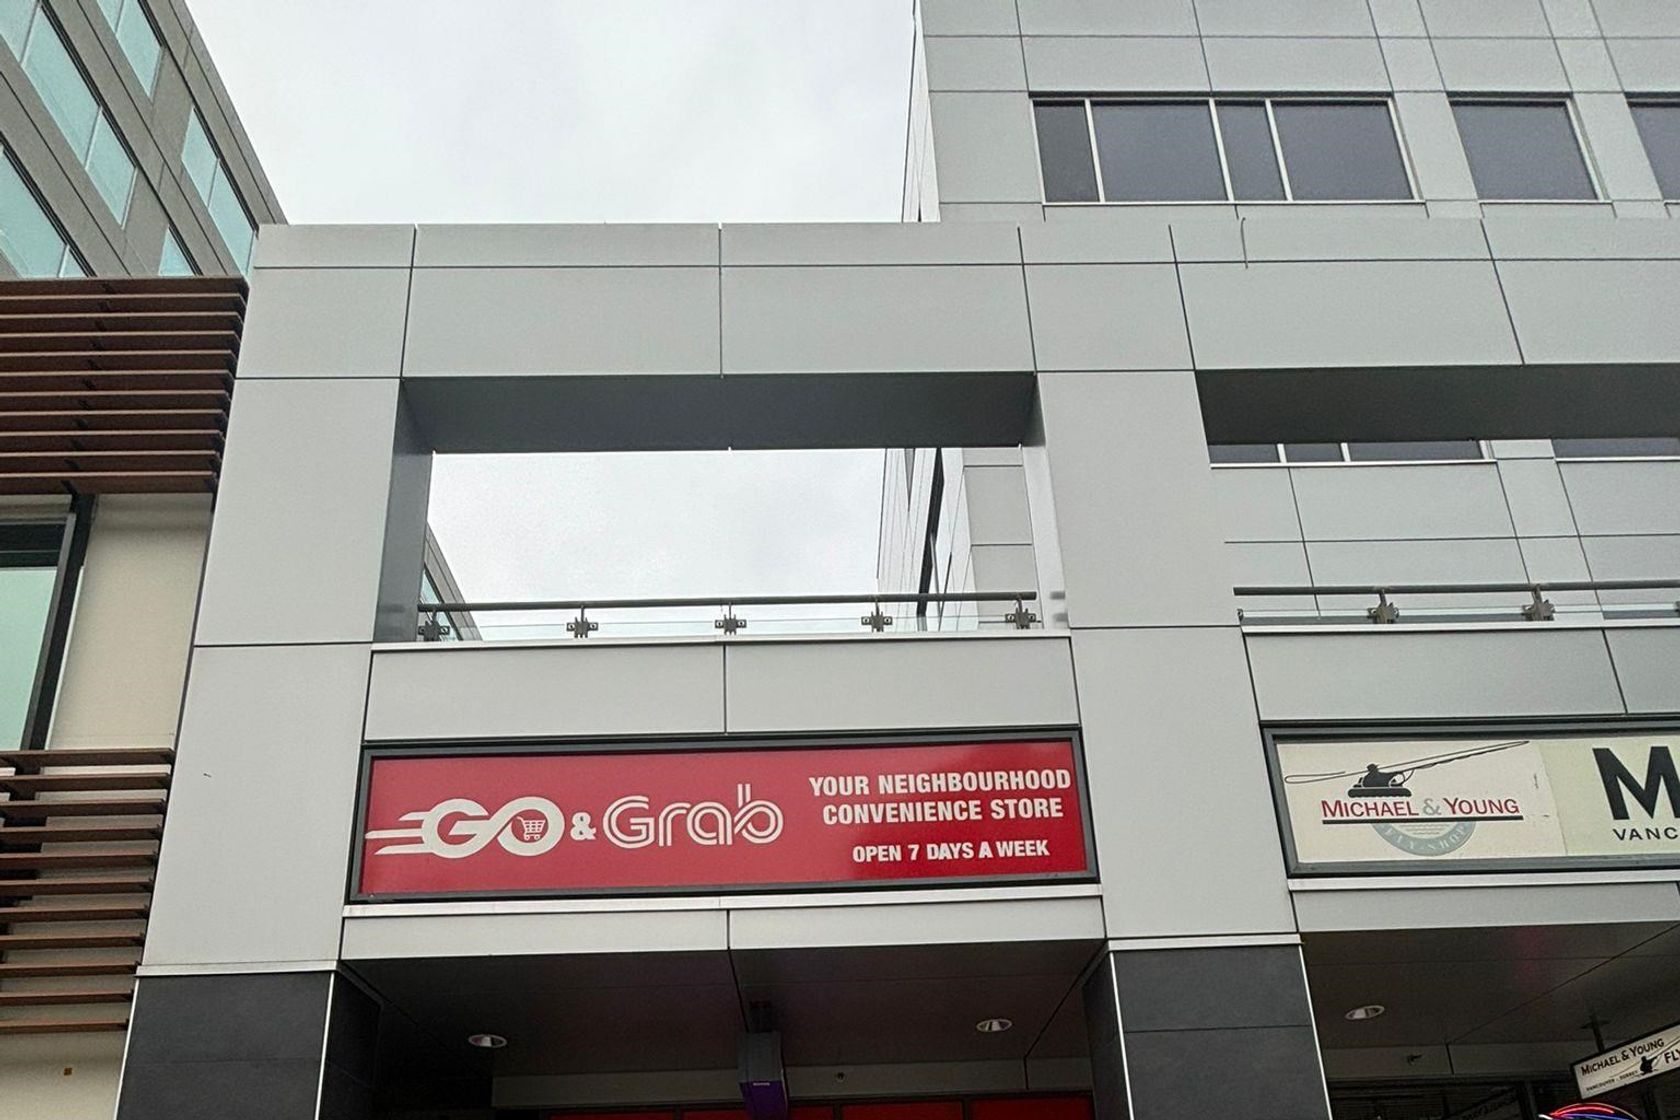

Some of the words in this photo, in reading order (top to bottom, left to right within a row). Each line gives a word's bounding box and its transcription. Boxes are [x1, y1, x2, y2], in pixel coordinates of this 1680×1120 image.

[808, 775, 870, 797] YOUR
[879, 769, 1071, 795] NEIGHBOURHOOD
[822, 800, 982, 825] CONVENIENCE
[990, 797, 1064, 819] STORE
[1422, 798, 1442, 816] &
[416, 796, 565, 858] GO
[570, 812, 597, 841] &
[602, 783, 785, 848] Grab
[1612, 826, 1679, 841] VANC
[852, 845, 902, 863] OPEN
[907, 844, 920, 861] 7
[927, 842, 975, 860] DAYS
[978, 841, 993, 859] A
[996, 840, 1050, 858] WEEK
